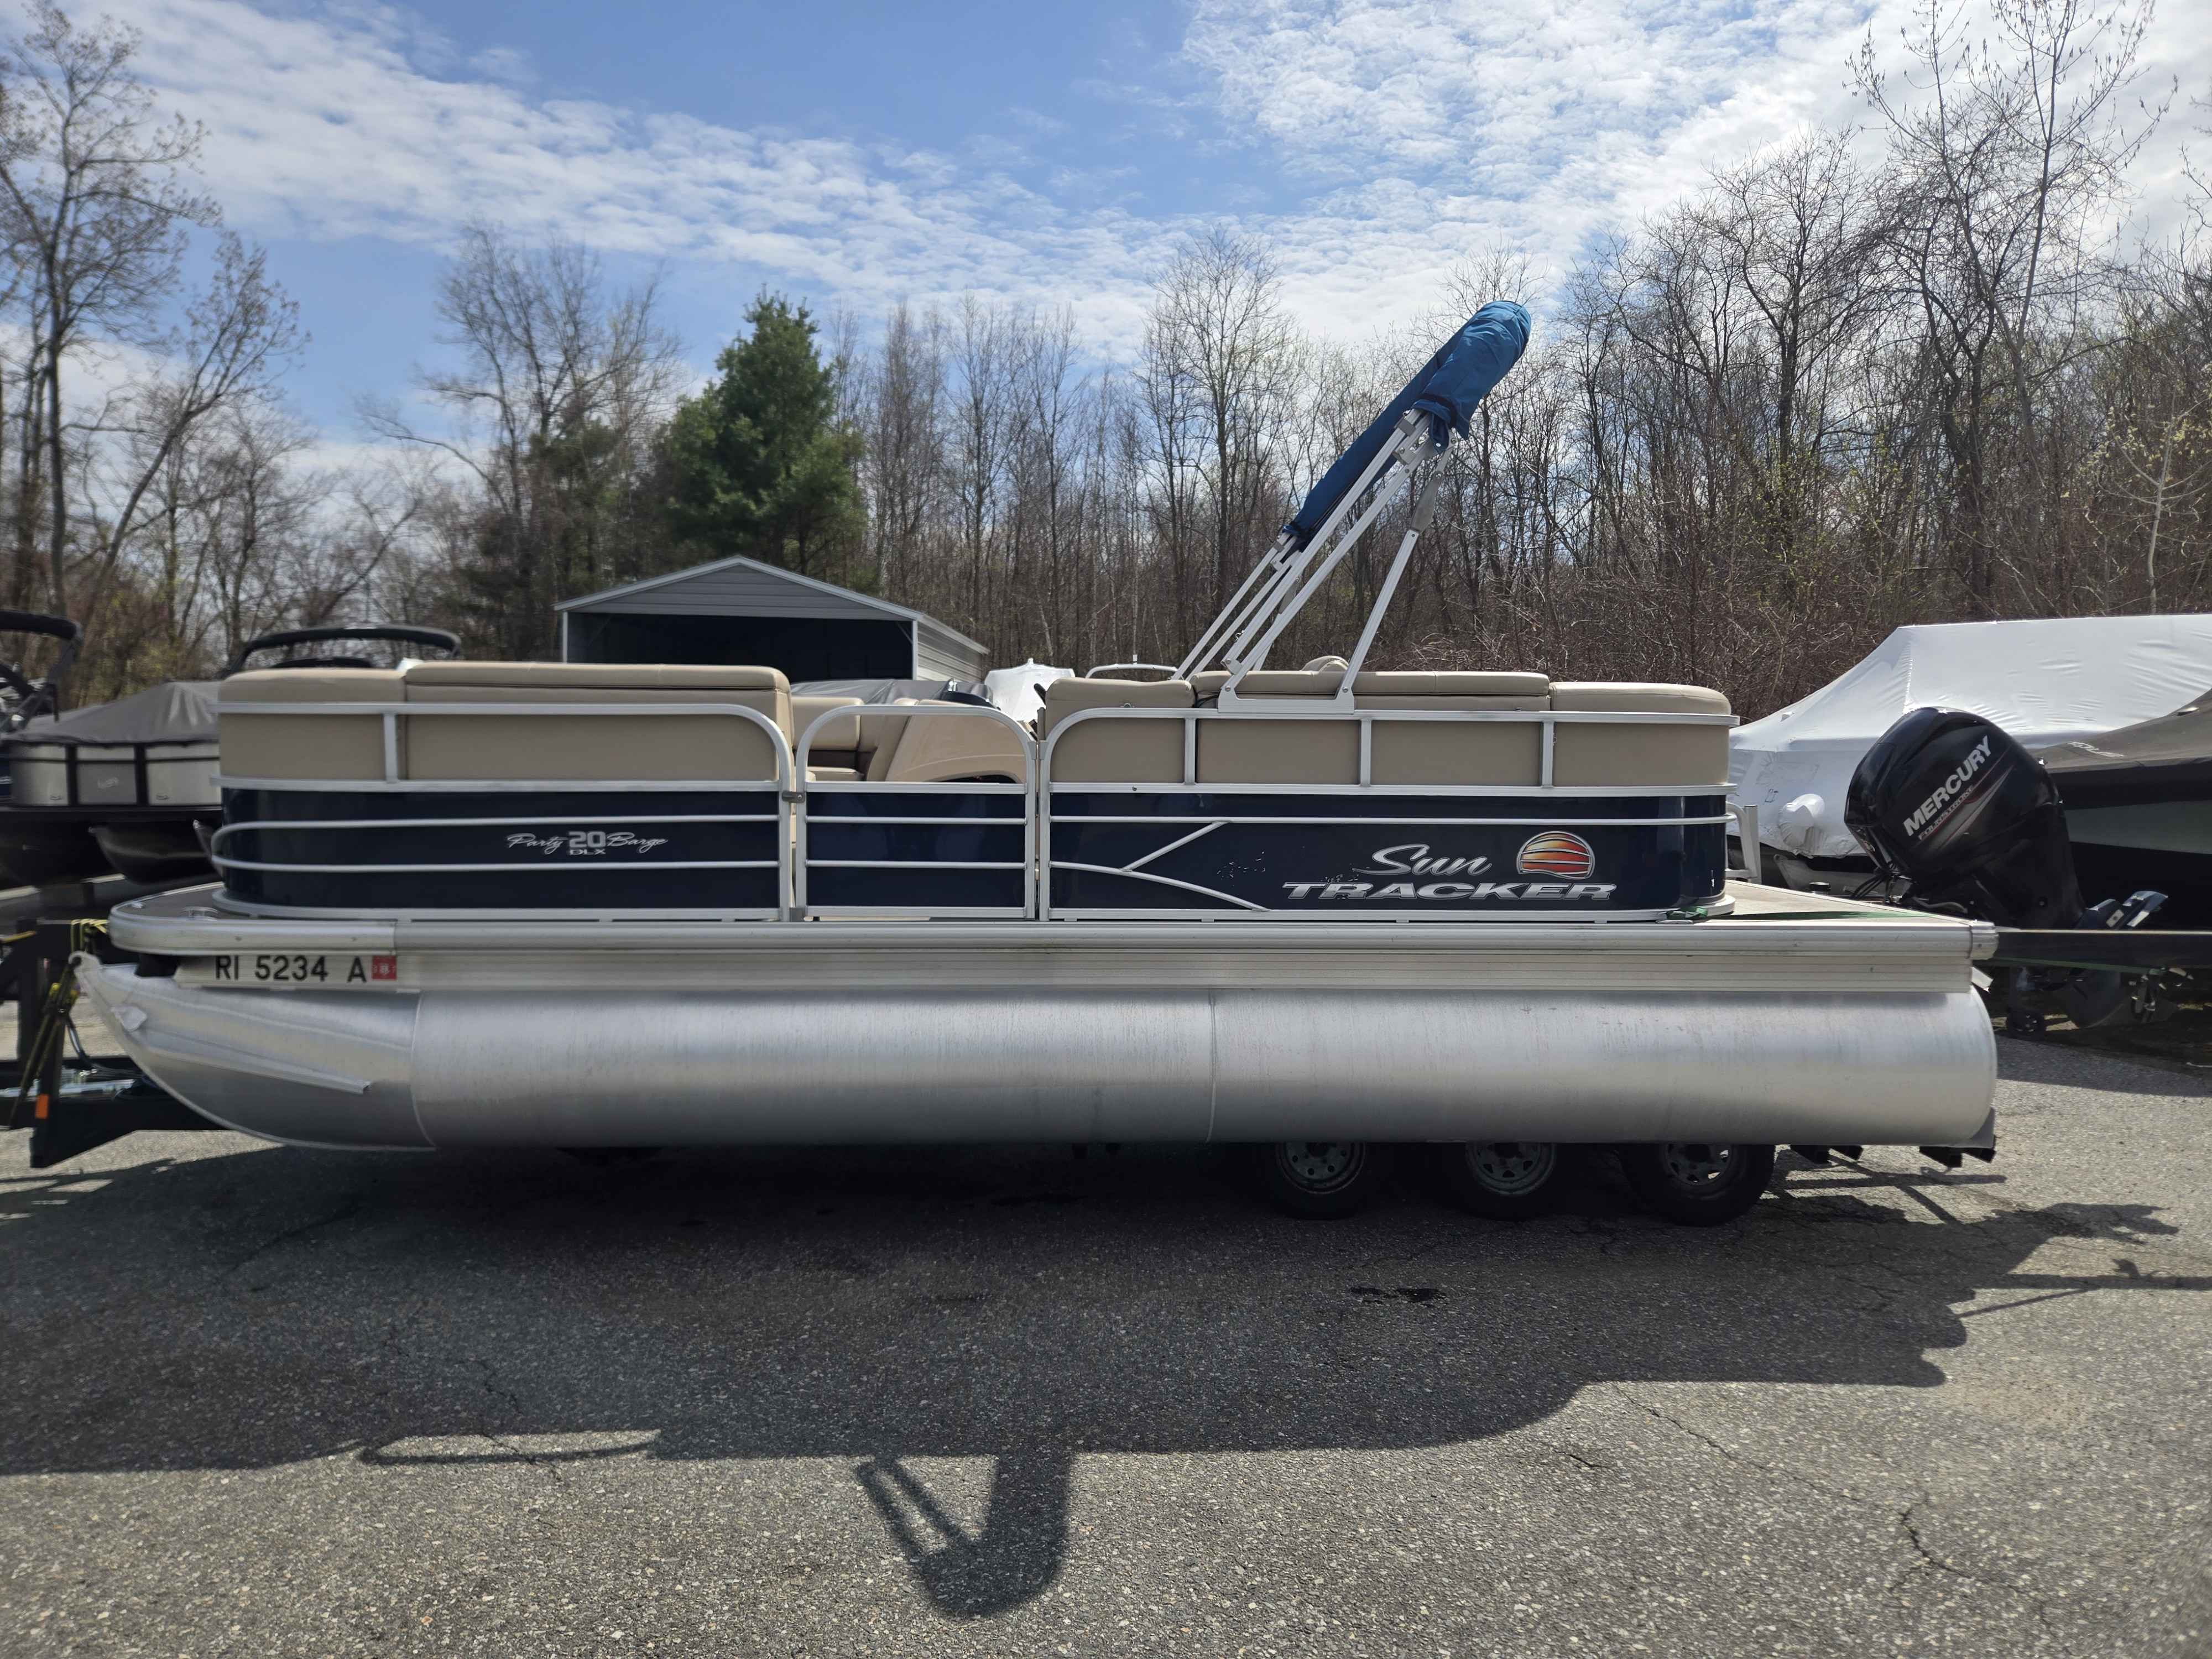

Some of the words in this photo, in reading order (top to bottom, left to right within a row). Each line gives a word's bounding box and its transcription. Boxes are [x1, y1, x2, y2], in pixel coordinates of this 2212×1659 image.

[1903, 735, 1991, 837] MERCURY
[507, 833, 568, 854] Party
[568, 831, 606, 848] 20
[607, 831, 668, 853] Barge
[1352, 843, 1492, 875] Sun
[1282, 881, 1616, 900] TRACKER
[215, 954, 239, 980] RI
[254, 954, 328, 982] 5234
[347, 956, 367, 983] A
